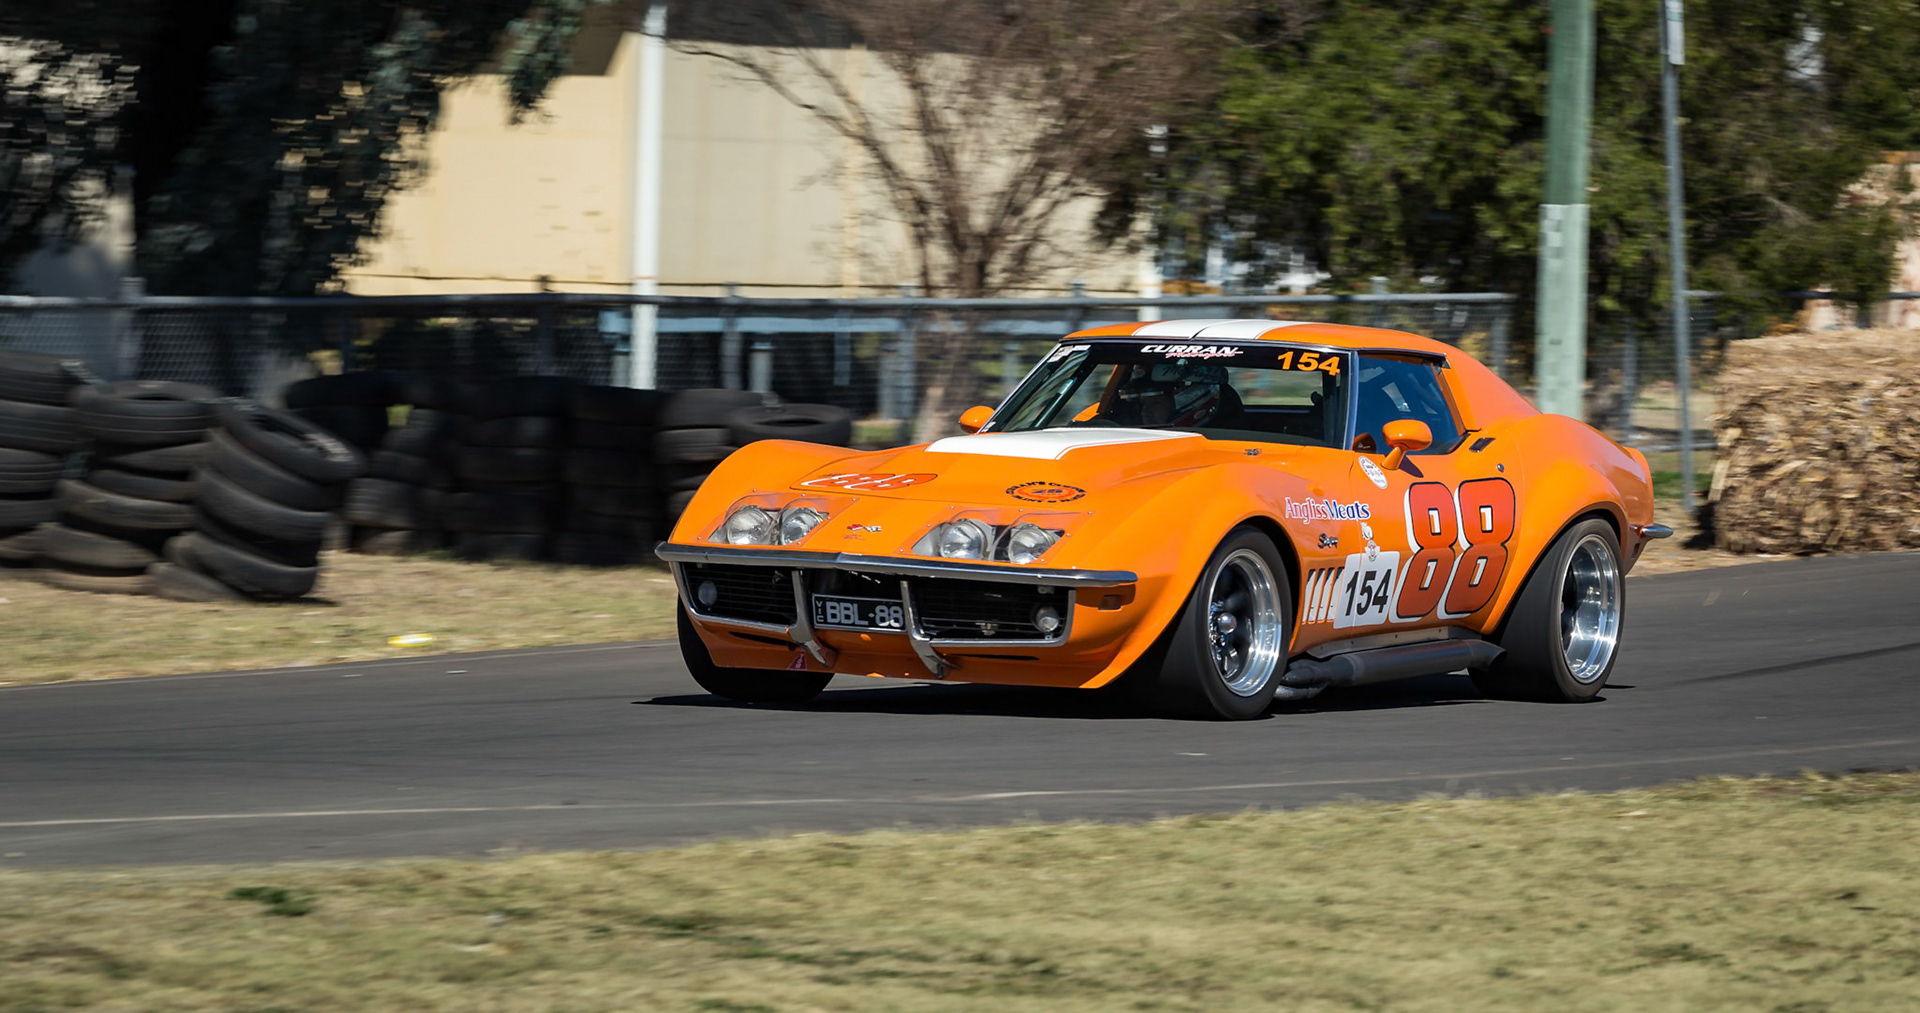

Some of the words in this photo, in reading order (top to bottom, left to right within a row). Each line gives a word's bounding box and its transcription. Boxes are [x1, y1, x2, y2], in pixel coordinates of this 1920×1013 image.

[1140, 344, 1239, 355] CURRAN
[1277, 351, 1341, 376] 154
[1388, 477, 1516, 622] 88
[1345, 569, 1392, 617] 154
[815, 601, 825, 622] VIC
